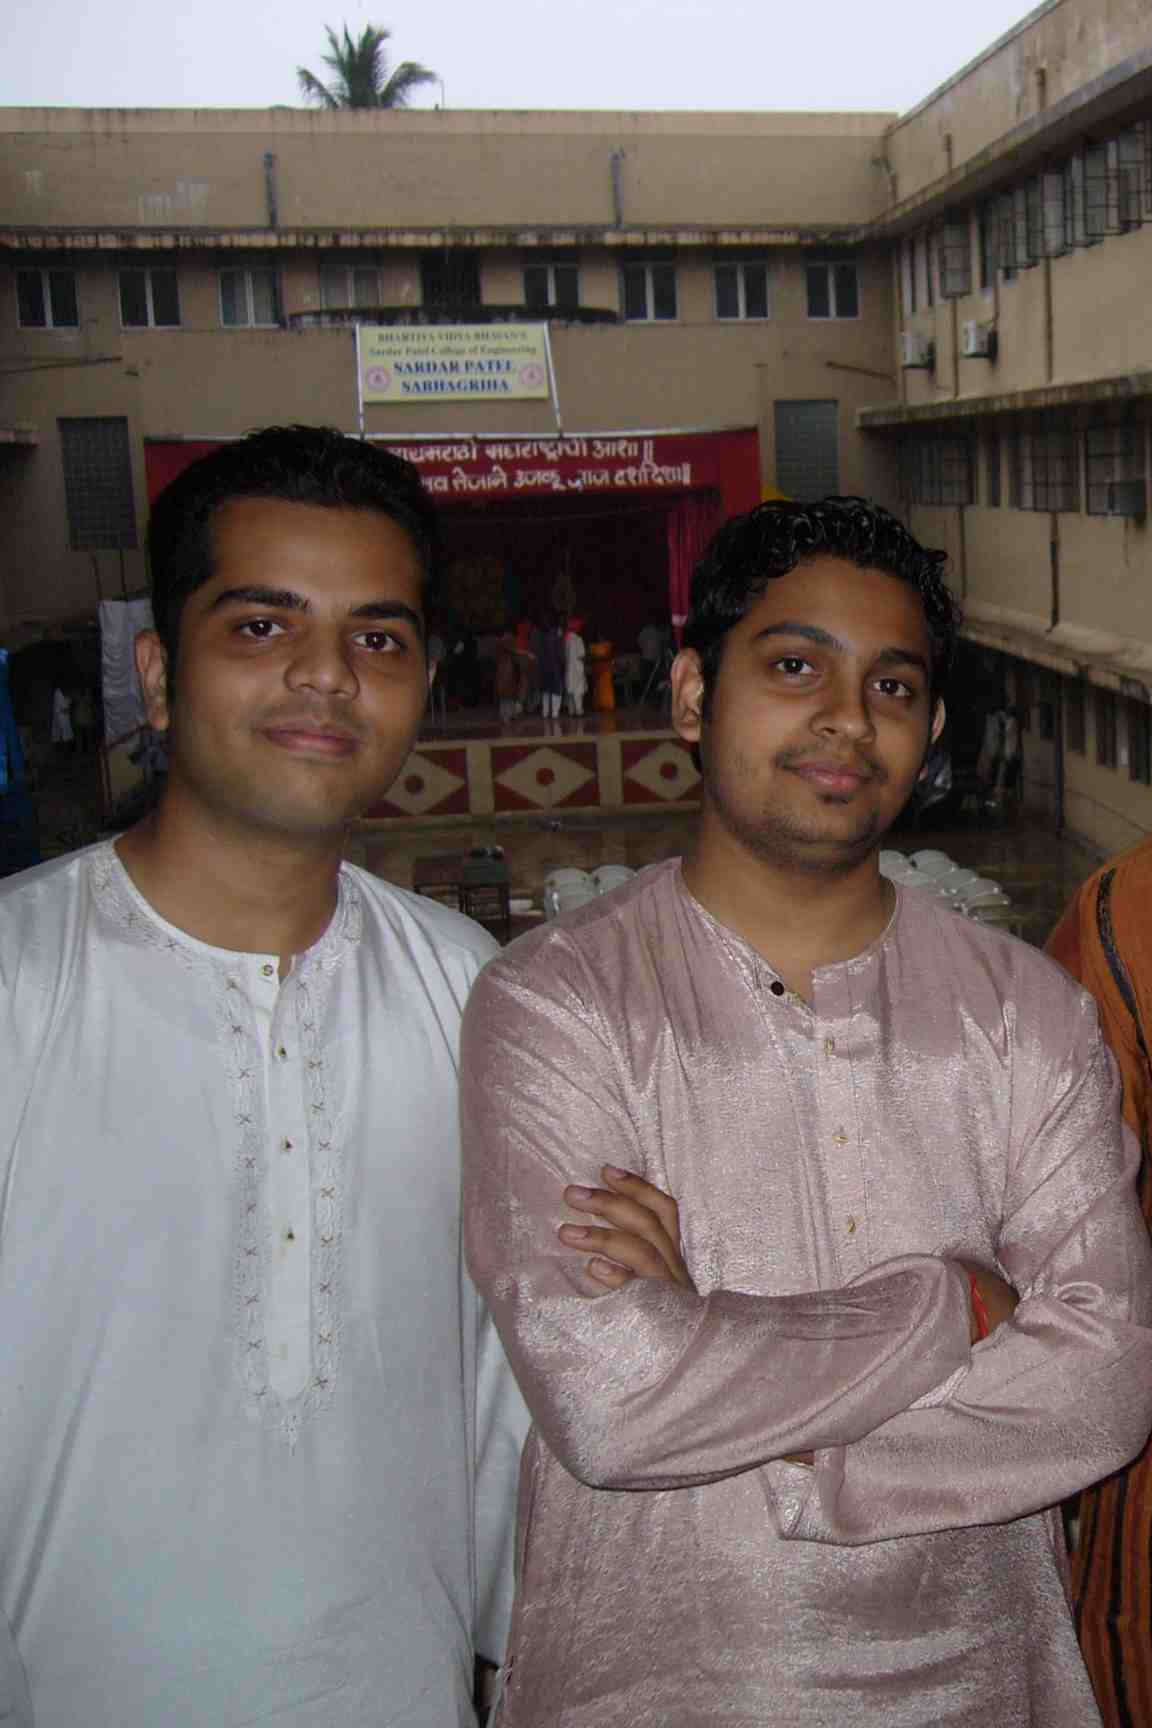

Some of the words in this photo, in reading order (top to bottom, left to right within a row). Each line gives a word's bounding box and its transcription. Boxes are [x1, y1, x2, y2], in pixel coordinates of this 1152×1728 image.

[394, 360, 460, 375] SARDAR
[465, 359, 514, 374] PATEL
[401, 379, 511, 393] SABHAGRIHA
